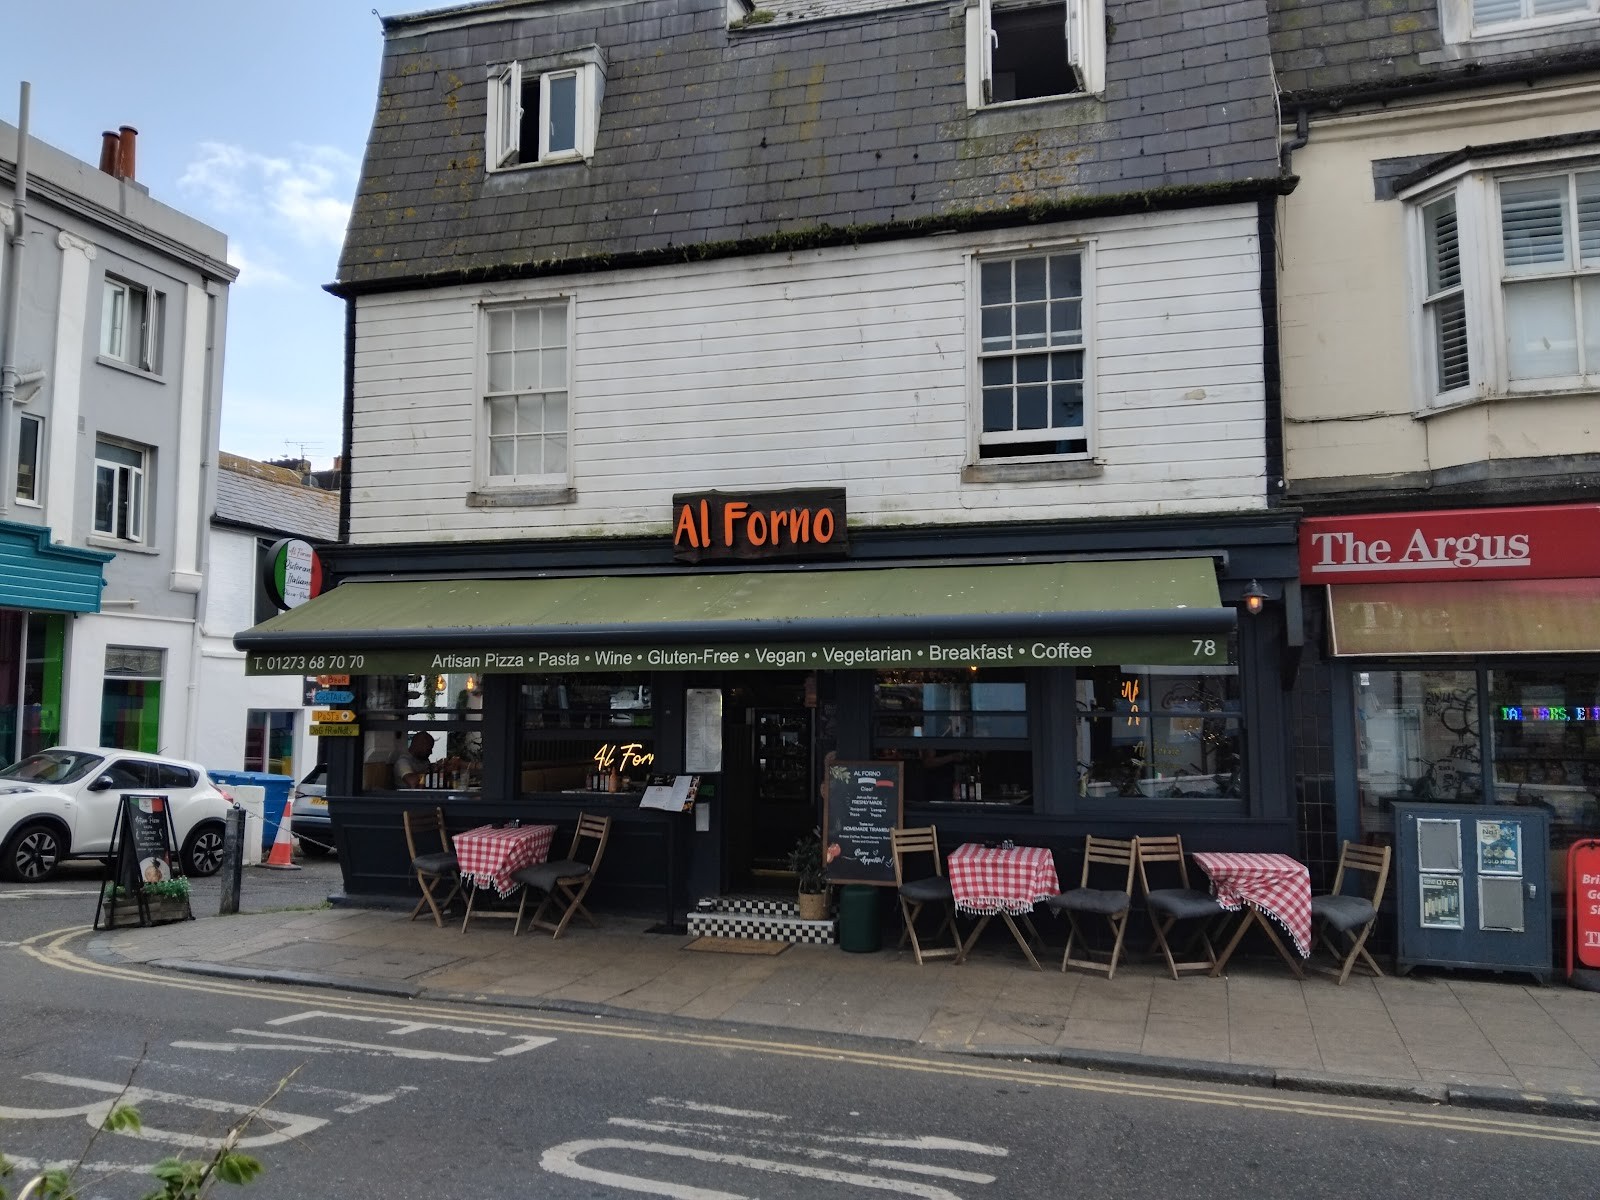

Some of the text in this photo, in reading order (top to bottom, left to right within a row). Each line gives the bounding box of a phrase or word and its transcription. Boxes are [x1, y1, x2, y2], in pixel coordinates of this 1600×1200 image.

[675, 499, 835, 548] Al Forno
[1311, 528, 1530, 568] The Argus
[254, 639, 1216, 670] T. 01273 68 70 70 Artisan Pizza Pasta Wine Gluten-Free Vegan Vegetarian Breakfast Coffee 78
